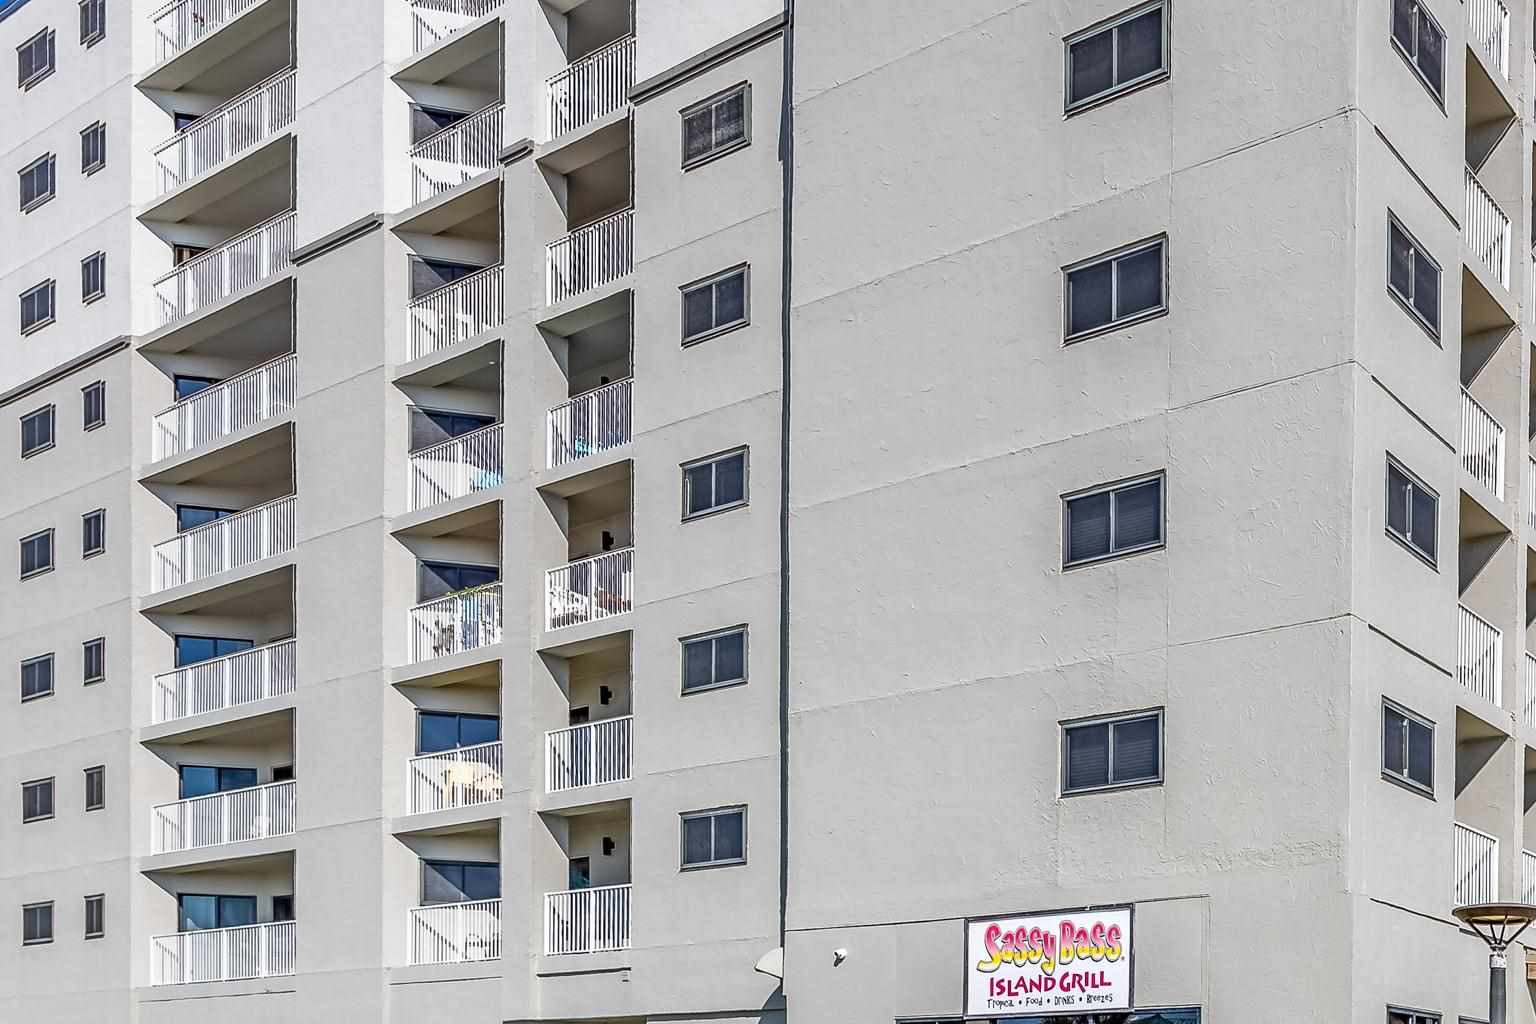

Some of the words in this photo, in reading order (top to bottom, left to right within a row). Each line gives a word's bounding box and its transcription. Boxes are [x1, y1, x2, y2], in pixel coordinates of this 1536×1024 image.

[976, 922, 1056, 976] Sassy
[1058, 919, 1122, 965] Bass
[989, 974, 1056, 997] ISLAND
[1059, 970, 1112, 993] GRILL
